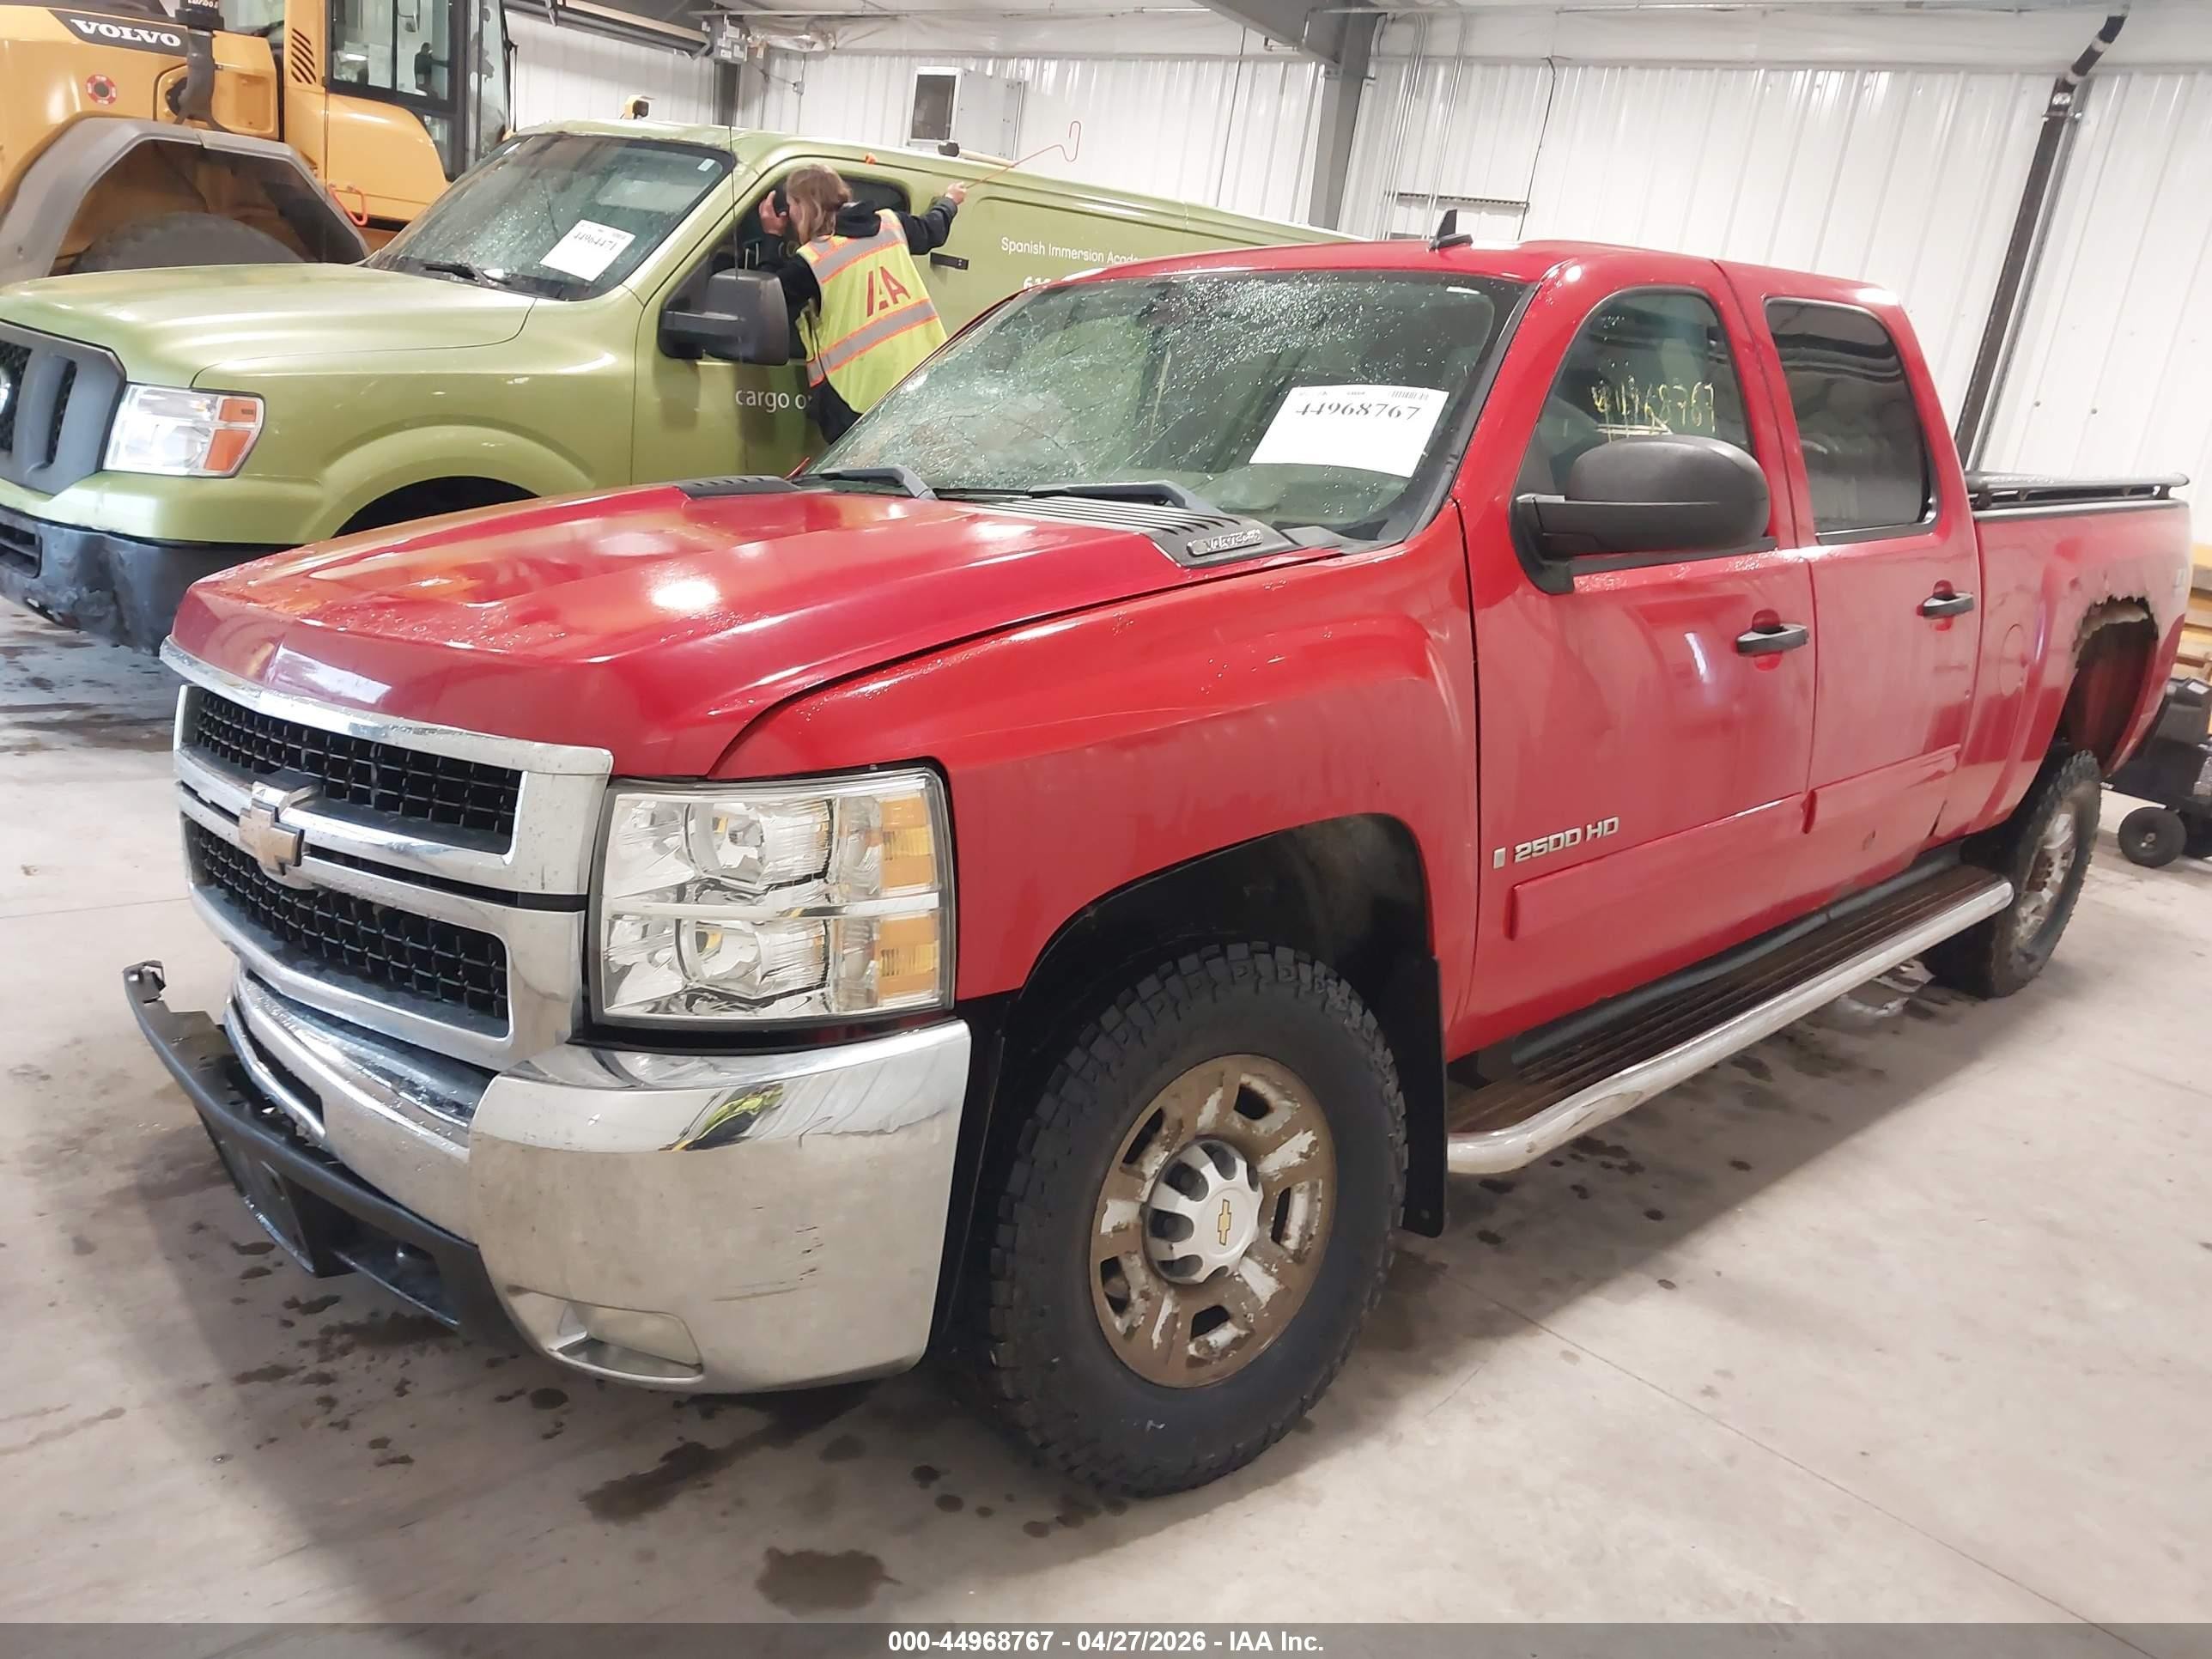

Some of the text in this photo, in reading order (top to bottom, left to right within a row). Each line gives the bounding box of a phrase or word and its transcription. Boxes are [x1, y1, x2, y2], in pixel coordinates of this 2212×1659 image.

[70, 18, 181, 47] VOLVO
[1001, 237, 1046, 255] Spanish
[1048, 243, 1105, 264] Immersion
[735, 389, 812, 413] cargo o
[1295, 402, 1422, 421] 44968767
[1514, 816, 1620, 864] 2500 HD
